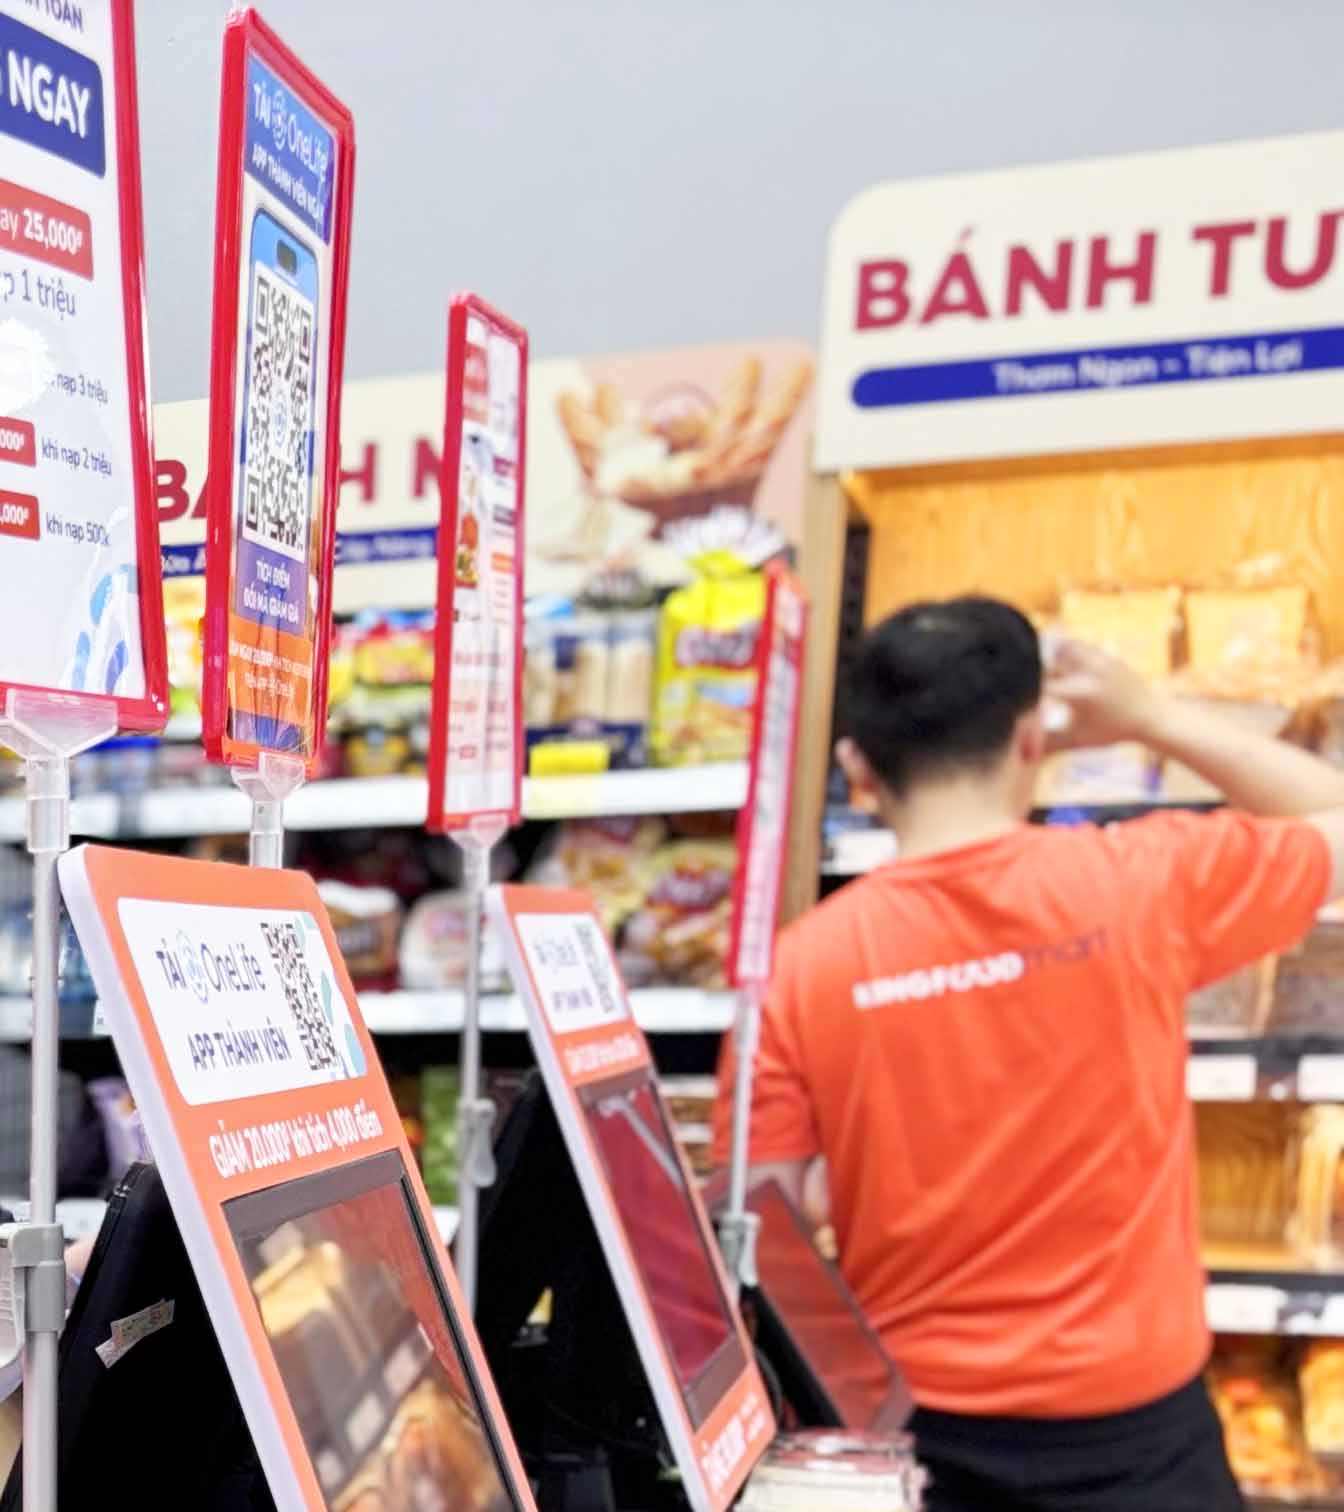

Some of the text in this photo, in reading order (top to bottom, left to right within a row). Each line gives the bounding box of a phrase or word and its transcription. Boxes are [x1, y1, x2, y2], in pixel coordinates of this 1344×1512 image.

[9, 51, 90, 138] NGAY
[22, 270, 31, 301] 1
[37, 277, 75, 320] triệu
[854, 225, 1158, 332] BÁNH
[42, 436, 58, 460] khi
[82, 448, 89, 472] 2
[46, 512, 63, 532] khi
[201, 942, 266, 991] OneLife
[187, 1033, 215, 1071] APP
[209, 1119, 250, 1178] GIẢM
